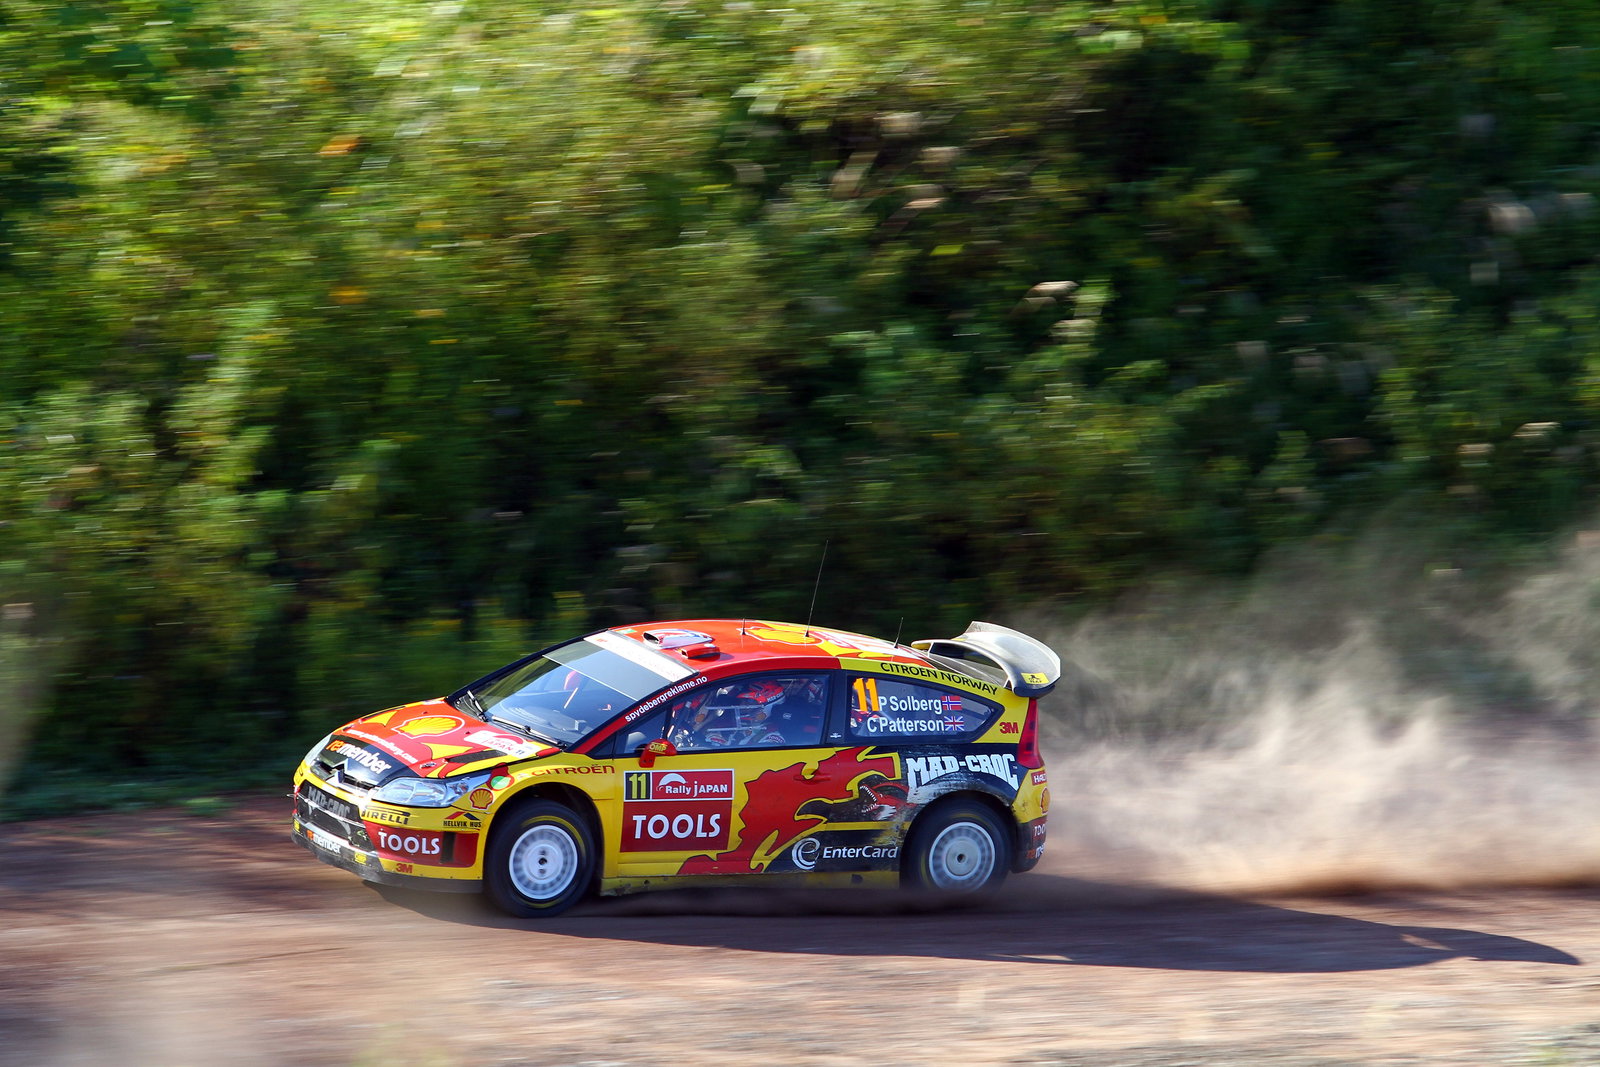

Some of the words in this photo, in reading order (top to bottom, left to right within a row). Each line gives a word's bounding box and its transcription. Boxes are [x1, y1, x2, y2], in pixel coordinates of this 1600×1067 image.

[881, 663, 938, 679] CITROEN
[940, 669, 998, 696] NORWAY
[624, 676, 708, 723] spydebergreklame.no
[853, 677, 880, 712] 11
[879, 696, 888, 711] P
[889, 695, 943, 715] Solberg
[866, 716, 878, 733] C
[880, 716, 945, 733] Patterson
[999, 721, 1019, 734] 3M
[325, 739, 392, 774] remember
[648, 741, 668, 753] OMP
[628, 773, 648, 800] 11
[905, 753, 1020, 802] MAD-CROC
[665, 785, 692, 796] Rally
[443, 820, 468, 828] HELLVIK
[632, 813, 721, 839] TOOLS
[377, 831, 441, 855] TOOLS
[822, 845, 899, 860] EnterCard
[395, 863, 413, 874] 3M
